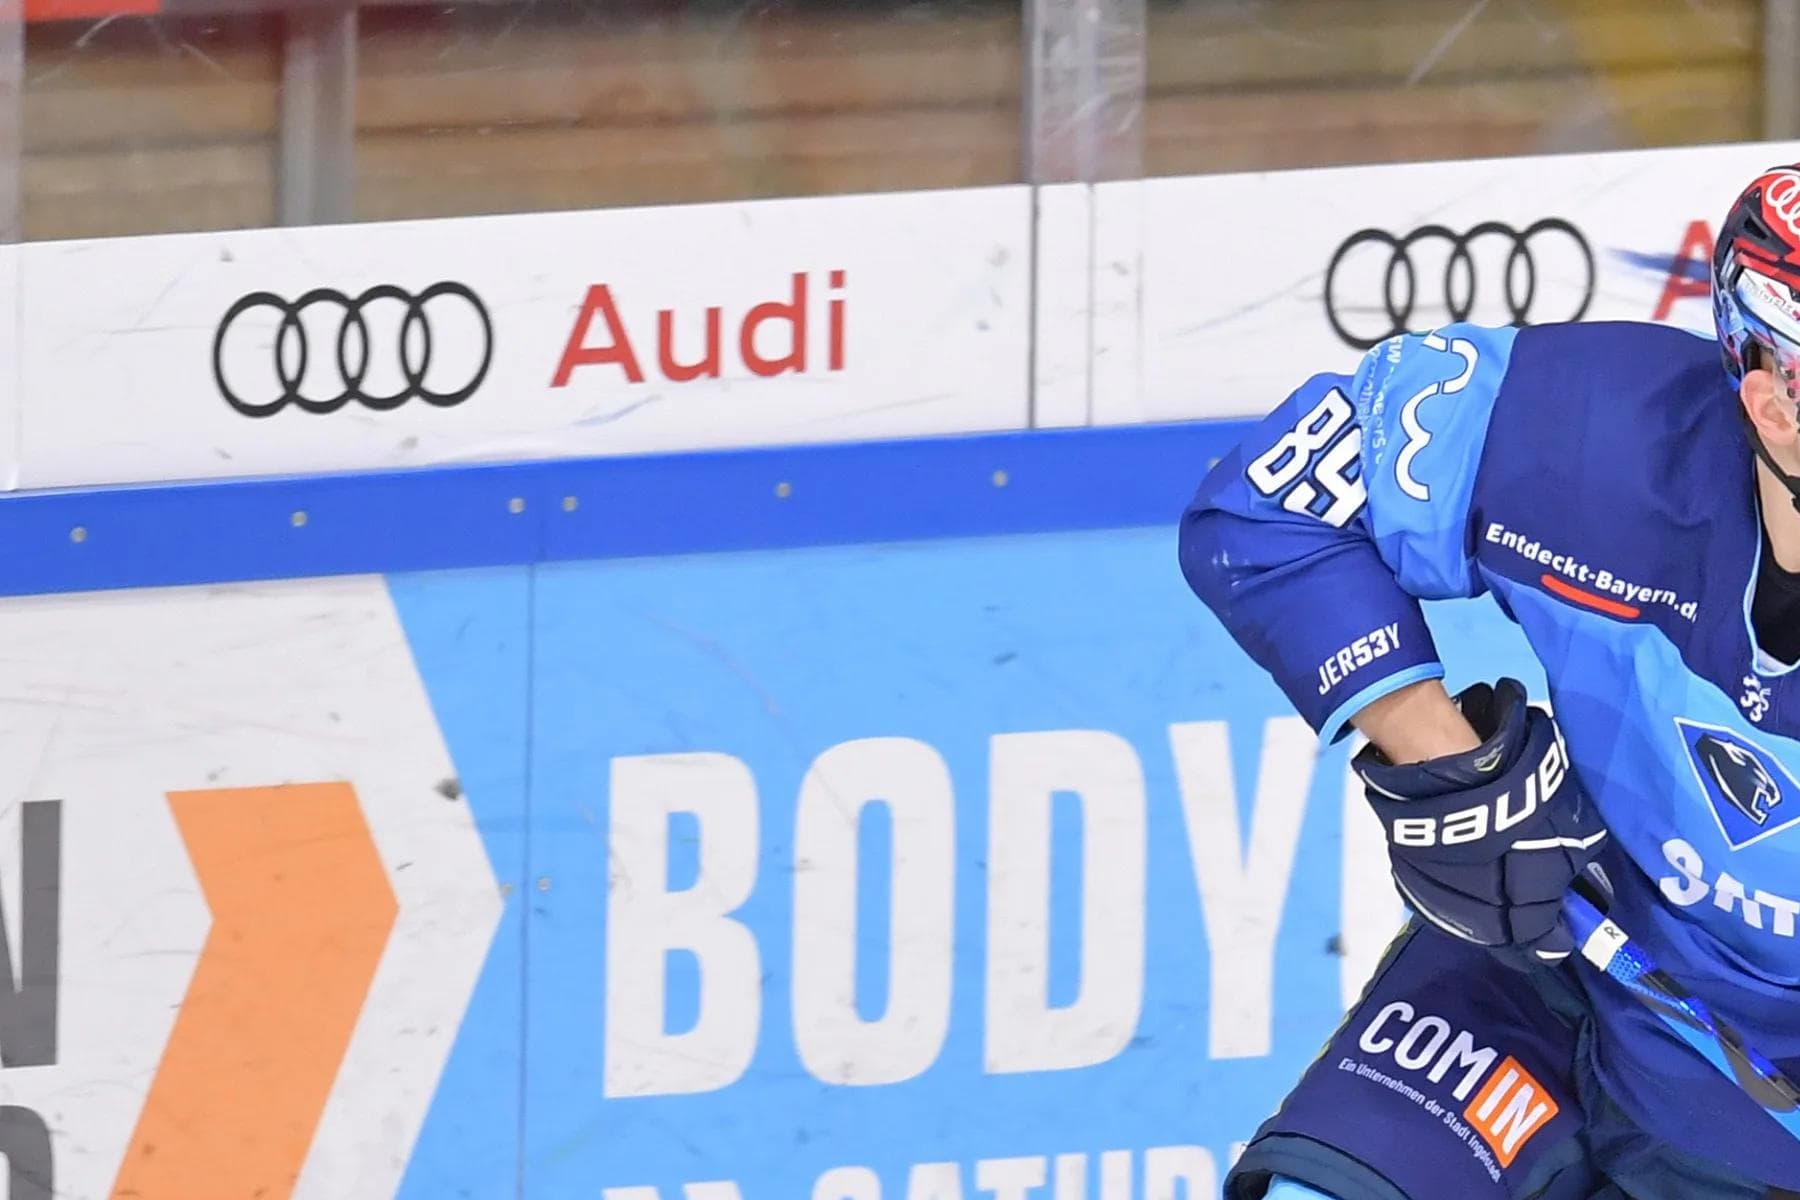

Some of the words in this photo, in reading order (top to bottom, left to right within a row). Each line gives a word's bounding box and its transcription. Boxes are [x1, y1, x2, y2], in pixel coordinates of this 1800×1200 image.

[550, 269, 847, 387] Audi
[1247, 386, 1367, 528] 89
[1338, 1057, 1356, 1073] Ein
[1356, 1061, 1426, 1104] Unternehmen
[1424, 1099, 1446, 1117] der
[1443, 1111, 1472, 1141] Stadt
